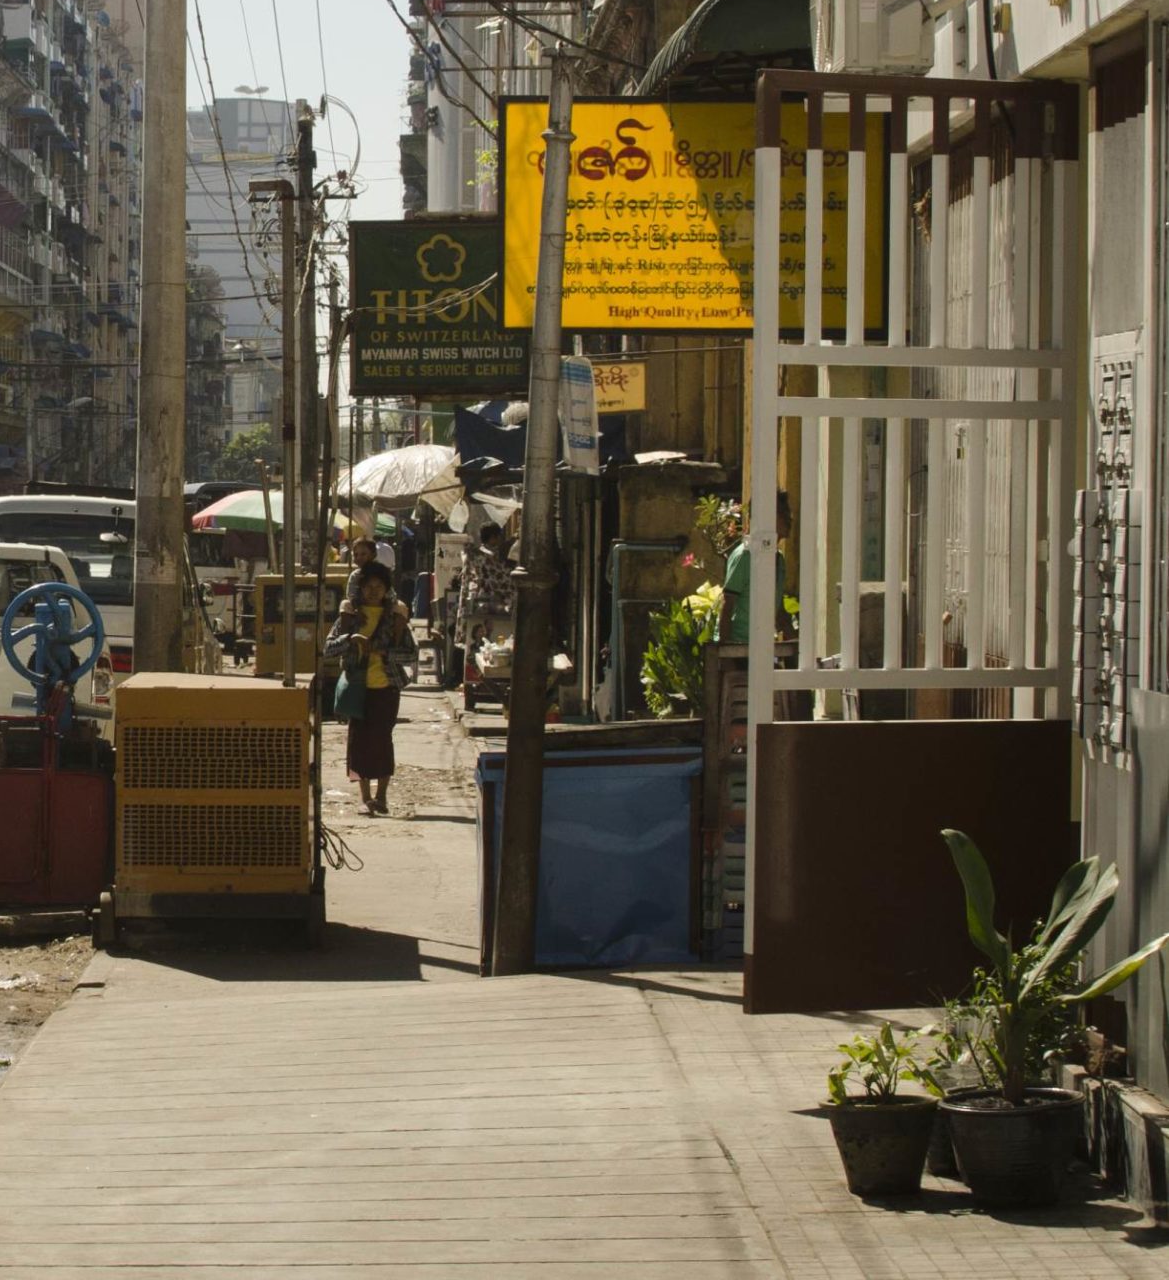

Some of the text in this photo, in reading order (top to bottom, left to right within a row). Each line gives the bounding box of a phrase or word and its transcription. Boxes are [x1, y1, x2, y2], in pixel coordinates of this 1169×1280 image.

[370, 287, 498, 325] TITON
[609, 305, 639, 319] High
[371, 330, 514, 342] OF SWITZERLAND
[361, 347, 523, 360] MYANMAR SWISS WATCH LTD
[364, 364, 522, 377] SALES & SERVICE CENTRE
